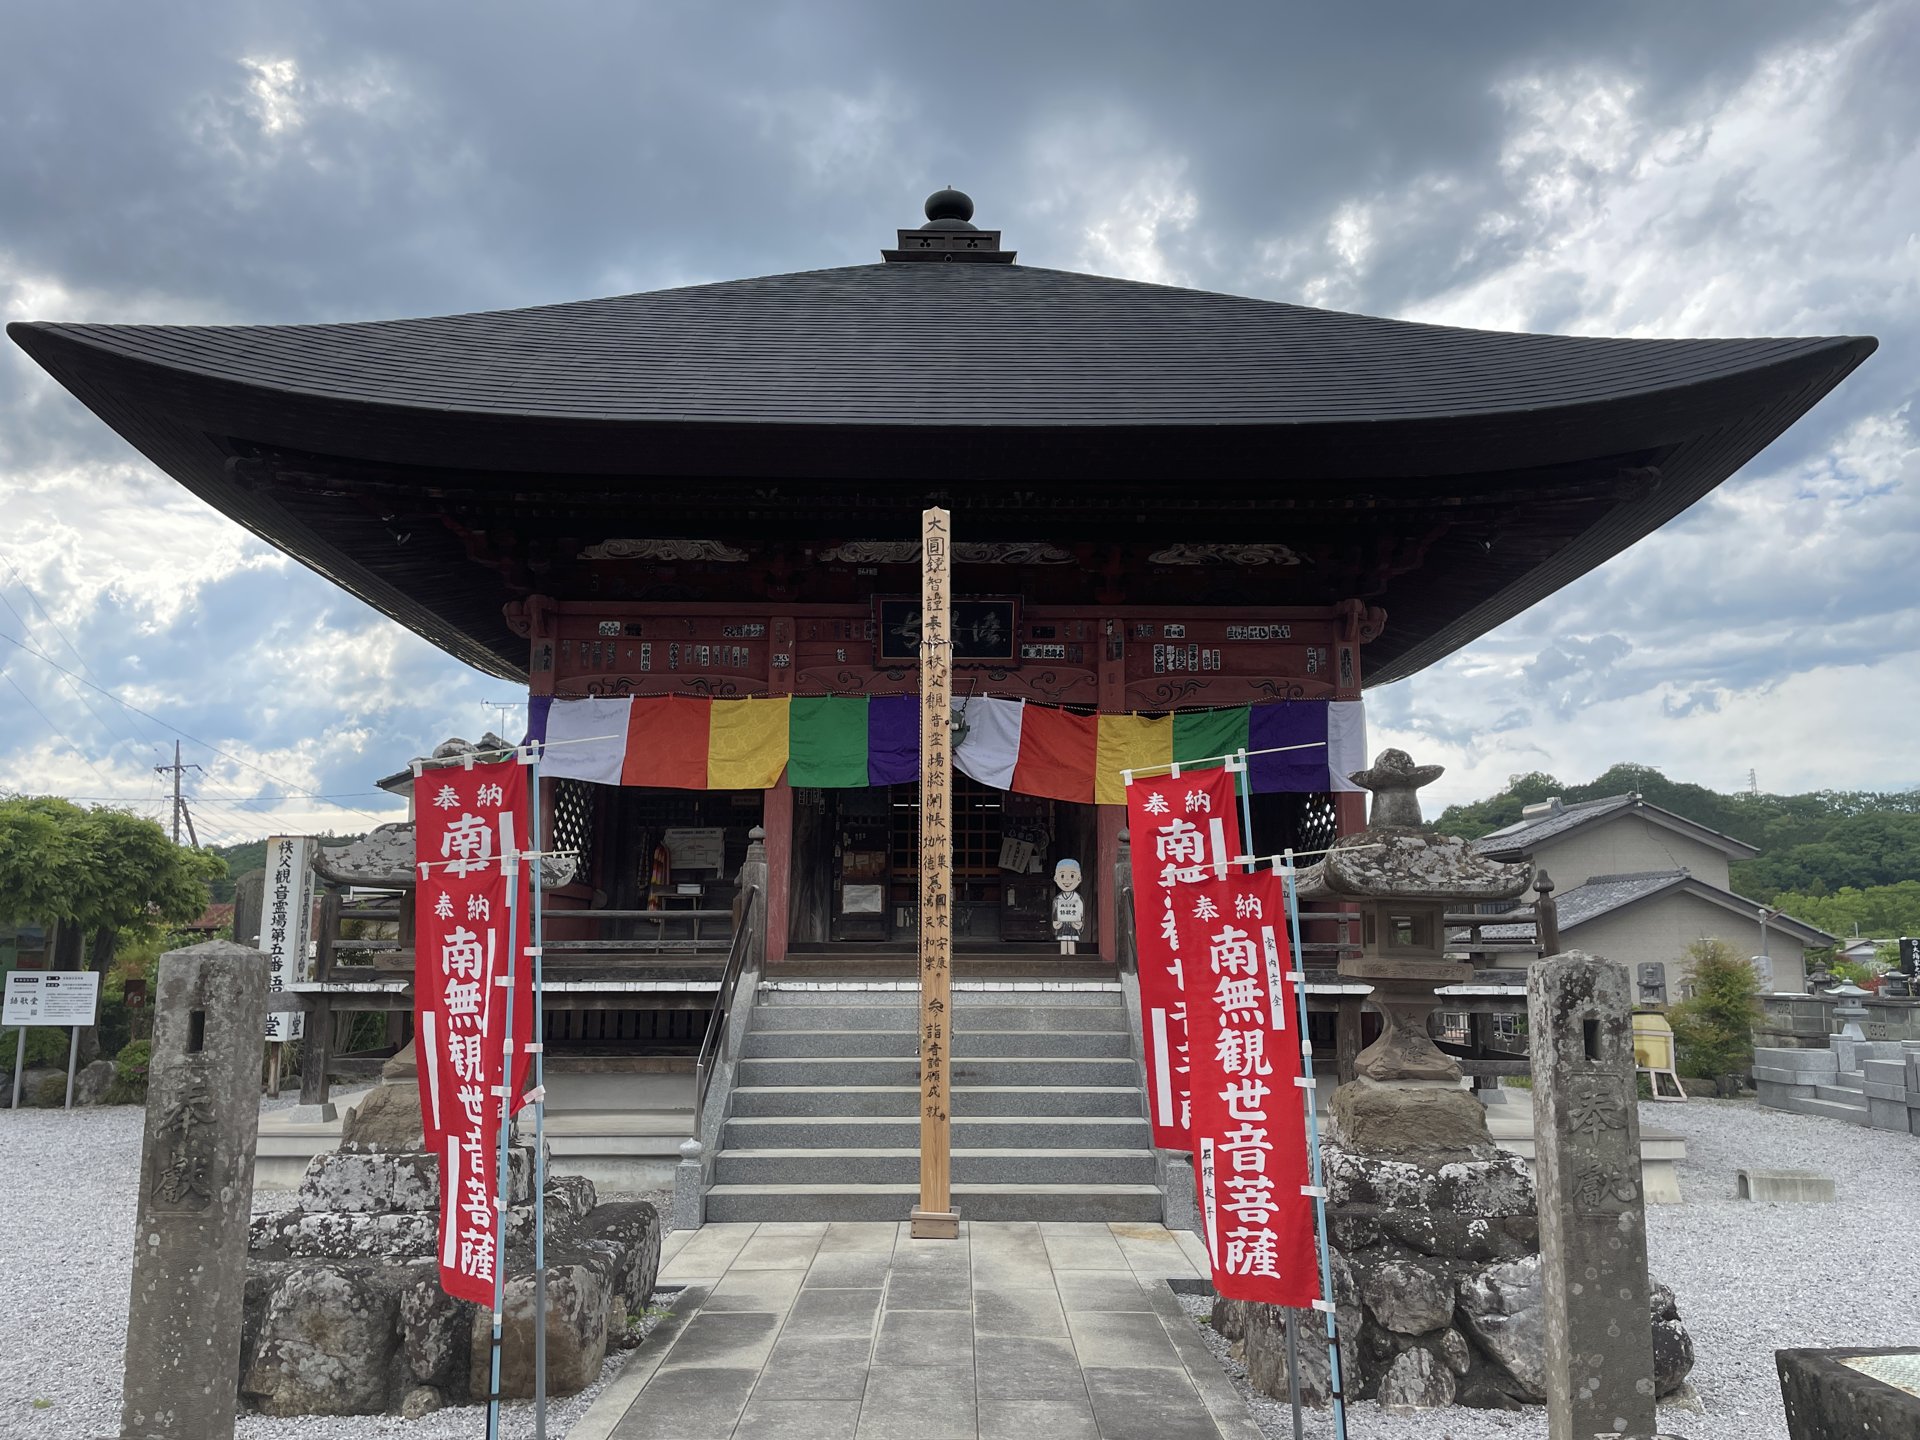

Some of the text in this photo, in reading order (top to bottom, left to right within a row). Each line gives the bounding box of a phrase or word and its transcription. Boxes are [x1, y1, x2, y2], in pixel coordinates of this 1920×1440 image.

[432, 783, 503, 811] 奉納
[1142, 790, 1211, 816] 奉納
[434, 891, 490, 922] 奉納
[1192, 893, 1262, 923] 奉納
[264, 841, 294, 1037] 秩父観音霊場第五番語堂
[1264, 937, 1282, 1007] 家内安全
[1210, 924, 1281, 1279] 南無観世音菩薩
[1202, 1149, 1215, 1220] 石塚友子
